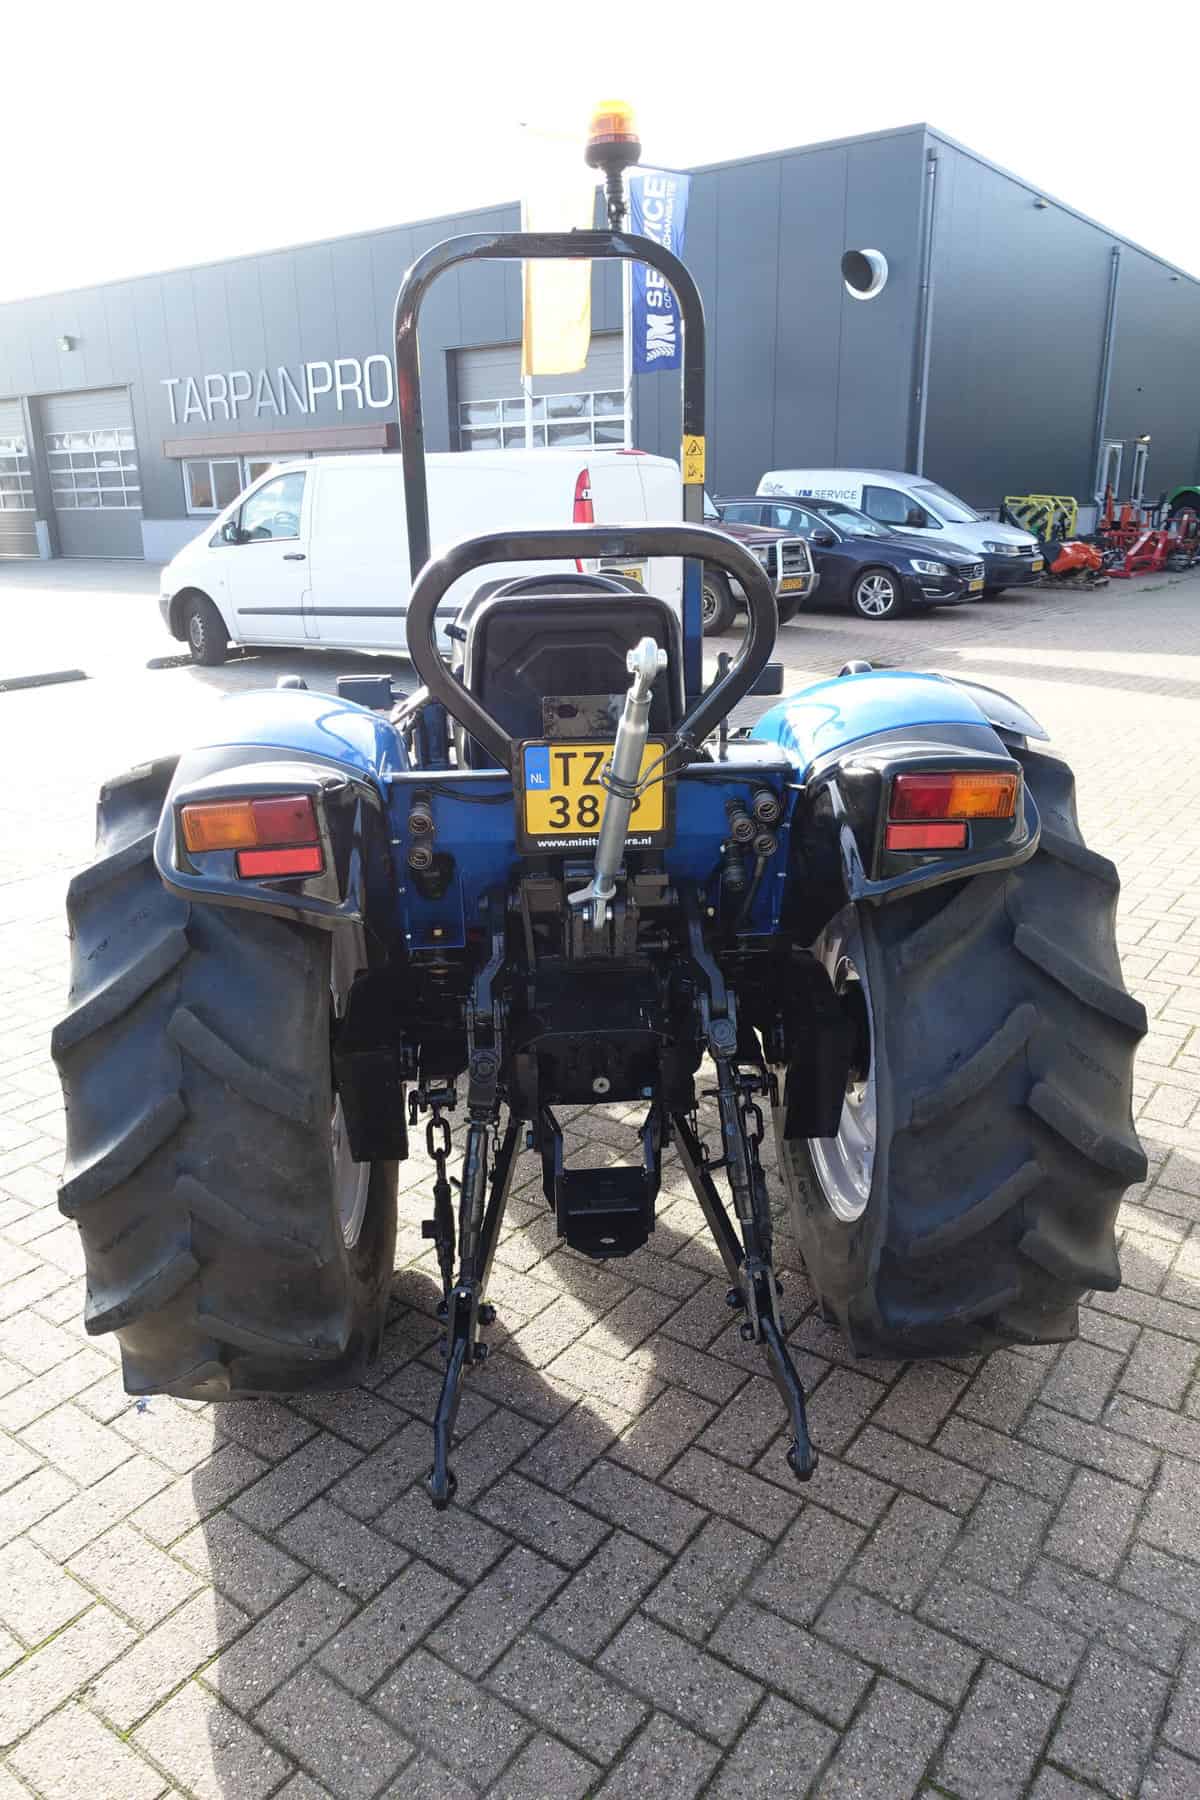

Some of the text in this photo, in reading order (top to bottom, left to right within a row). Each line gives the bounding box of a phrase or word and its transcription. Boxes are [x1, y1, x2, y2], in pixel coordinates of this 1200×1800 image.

[160, 354, 394, 424] TARPANPRO
[815, 489, 857, 500] SERVICE
[530, 773, 545, 784] NL
